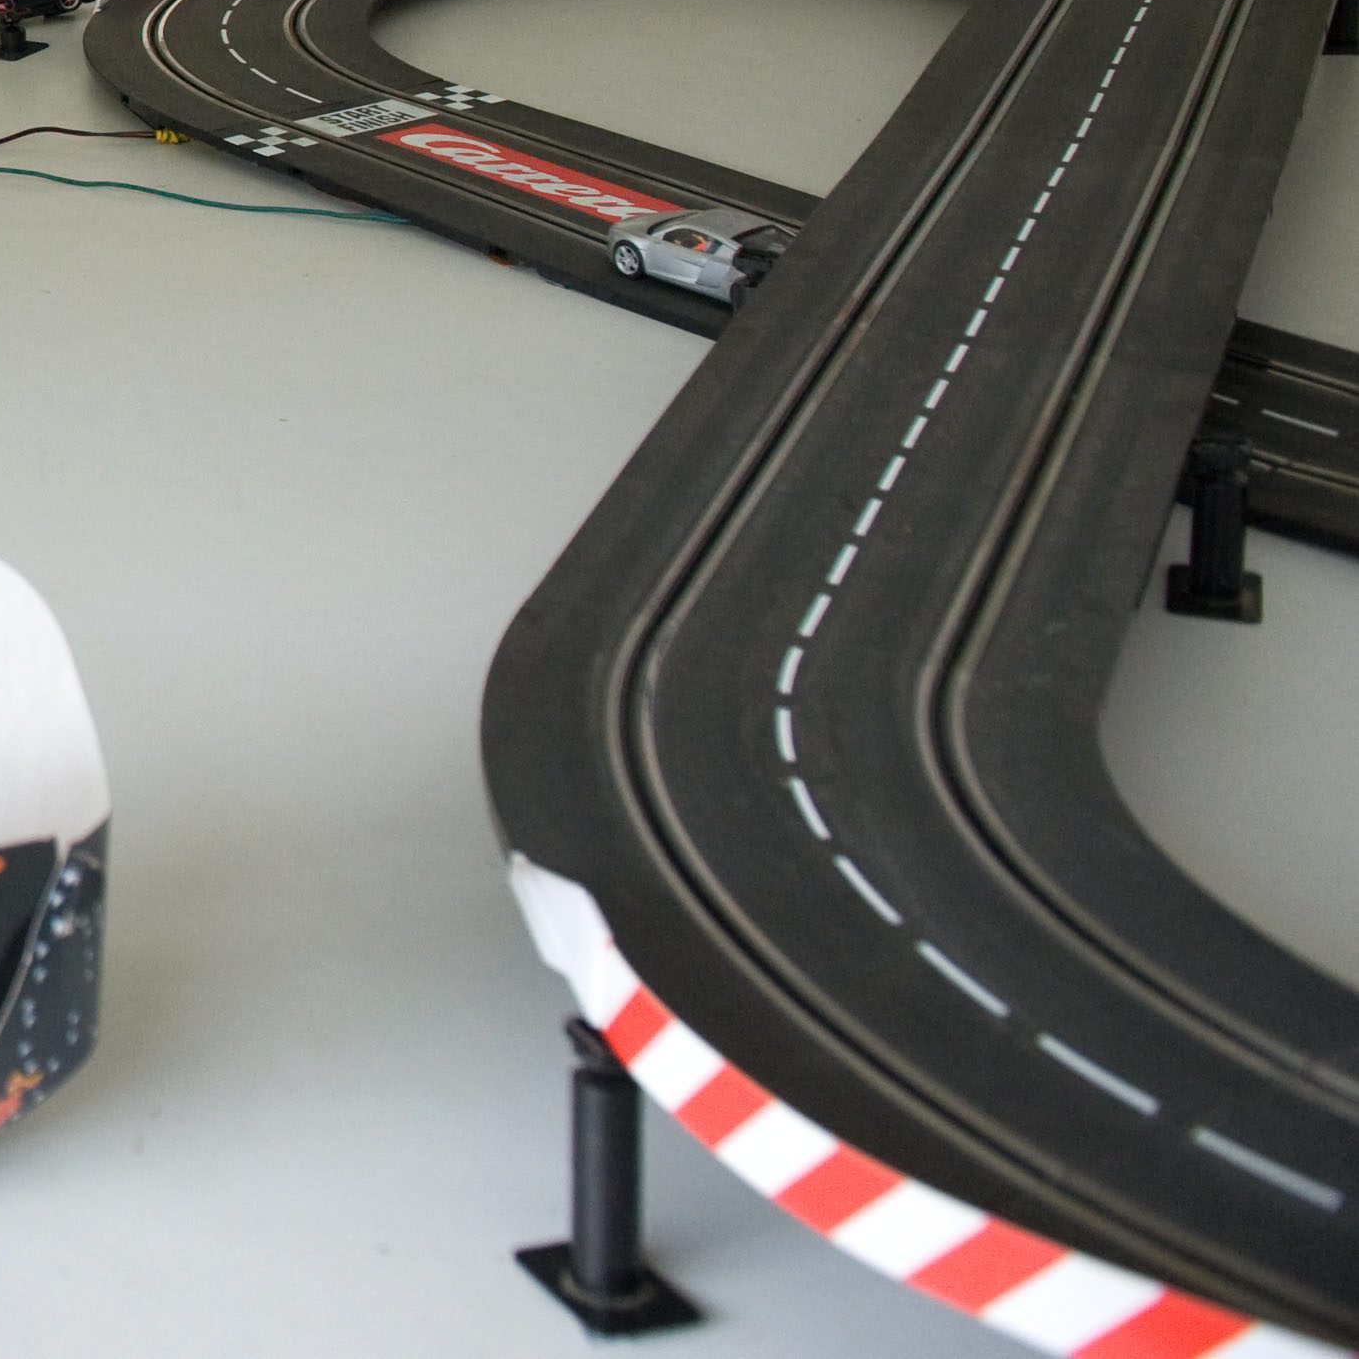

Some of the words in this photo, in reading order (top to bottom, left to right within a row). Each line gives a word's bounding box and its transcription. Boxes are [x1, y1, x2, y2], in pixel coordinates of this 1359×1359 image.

[318, 103, 389, 126] START
[342, 111, 416, 133] FINISH
[400, 133, 659, 219] Carrera
